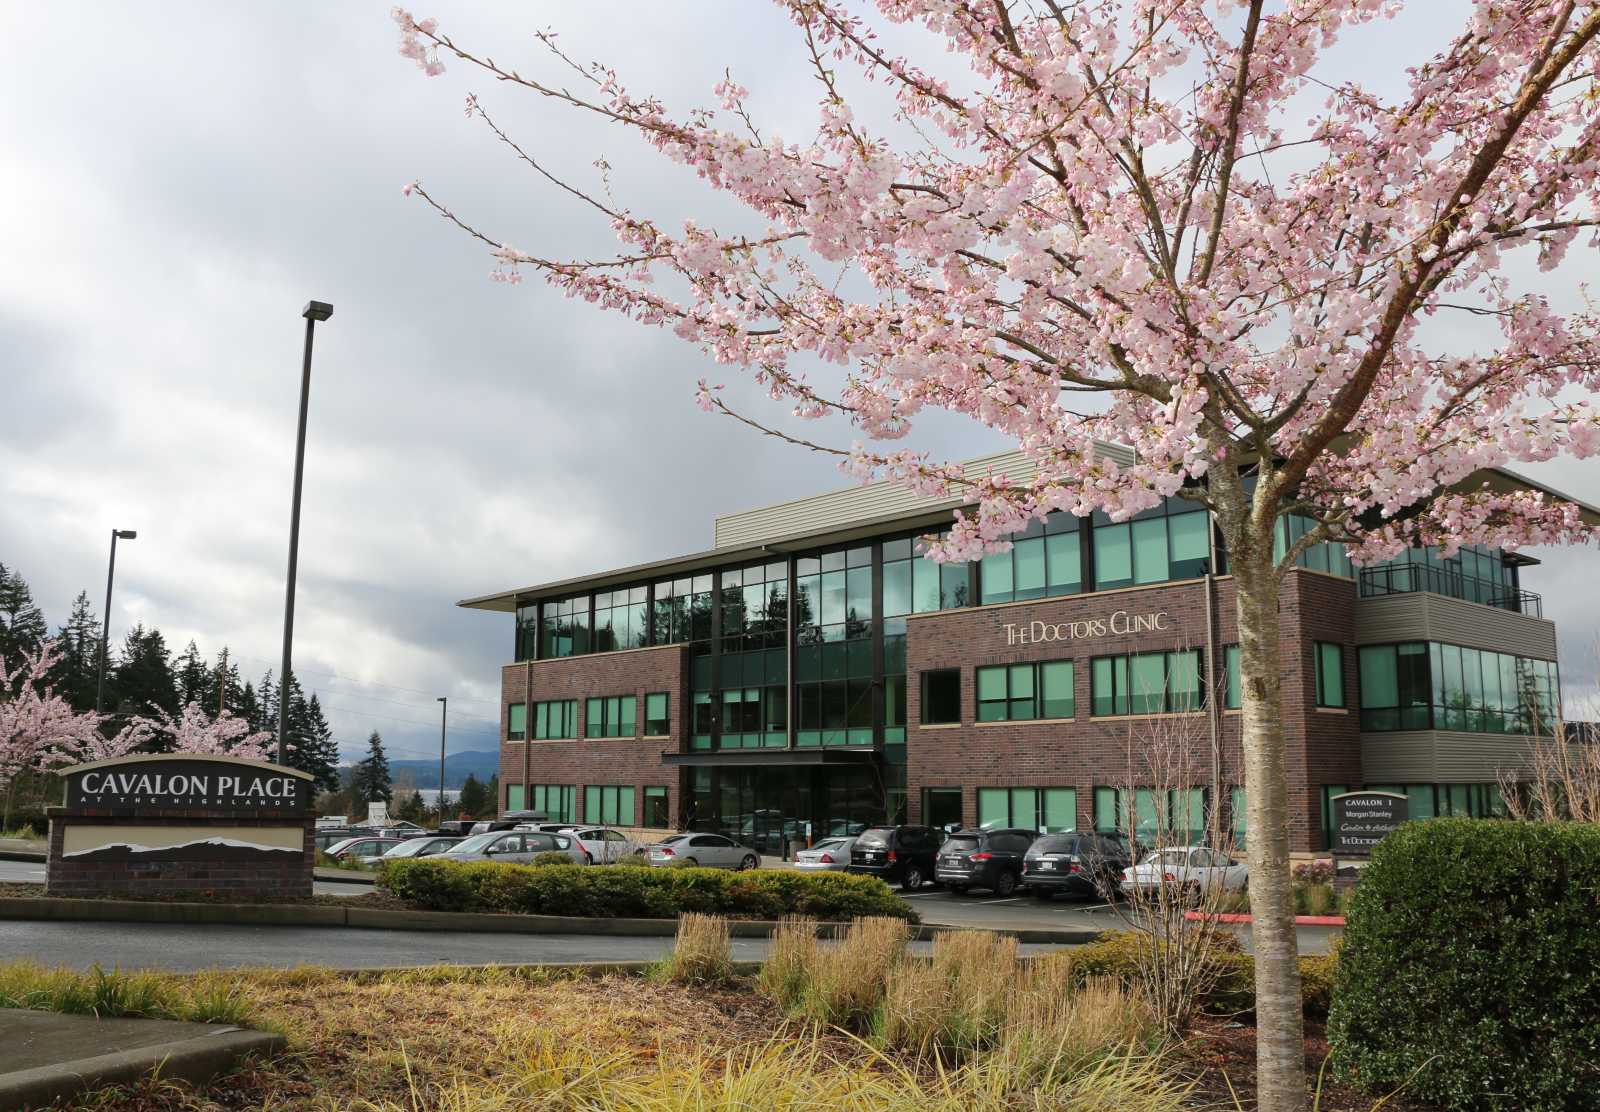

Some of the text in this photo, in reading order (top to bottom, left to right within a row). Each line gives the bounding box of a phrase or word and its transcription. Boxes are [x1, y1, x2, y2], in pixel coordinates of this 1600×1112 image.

[1003, 611, 1168, 646] THE DOCTORS CLINIC
[81, 773, 297, 798] CAVALON PLACE
[174, 798, 296, 806] HIGHLANDS
[1345, 811, 1392, 819] Morgan Stanley
